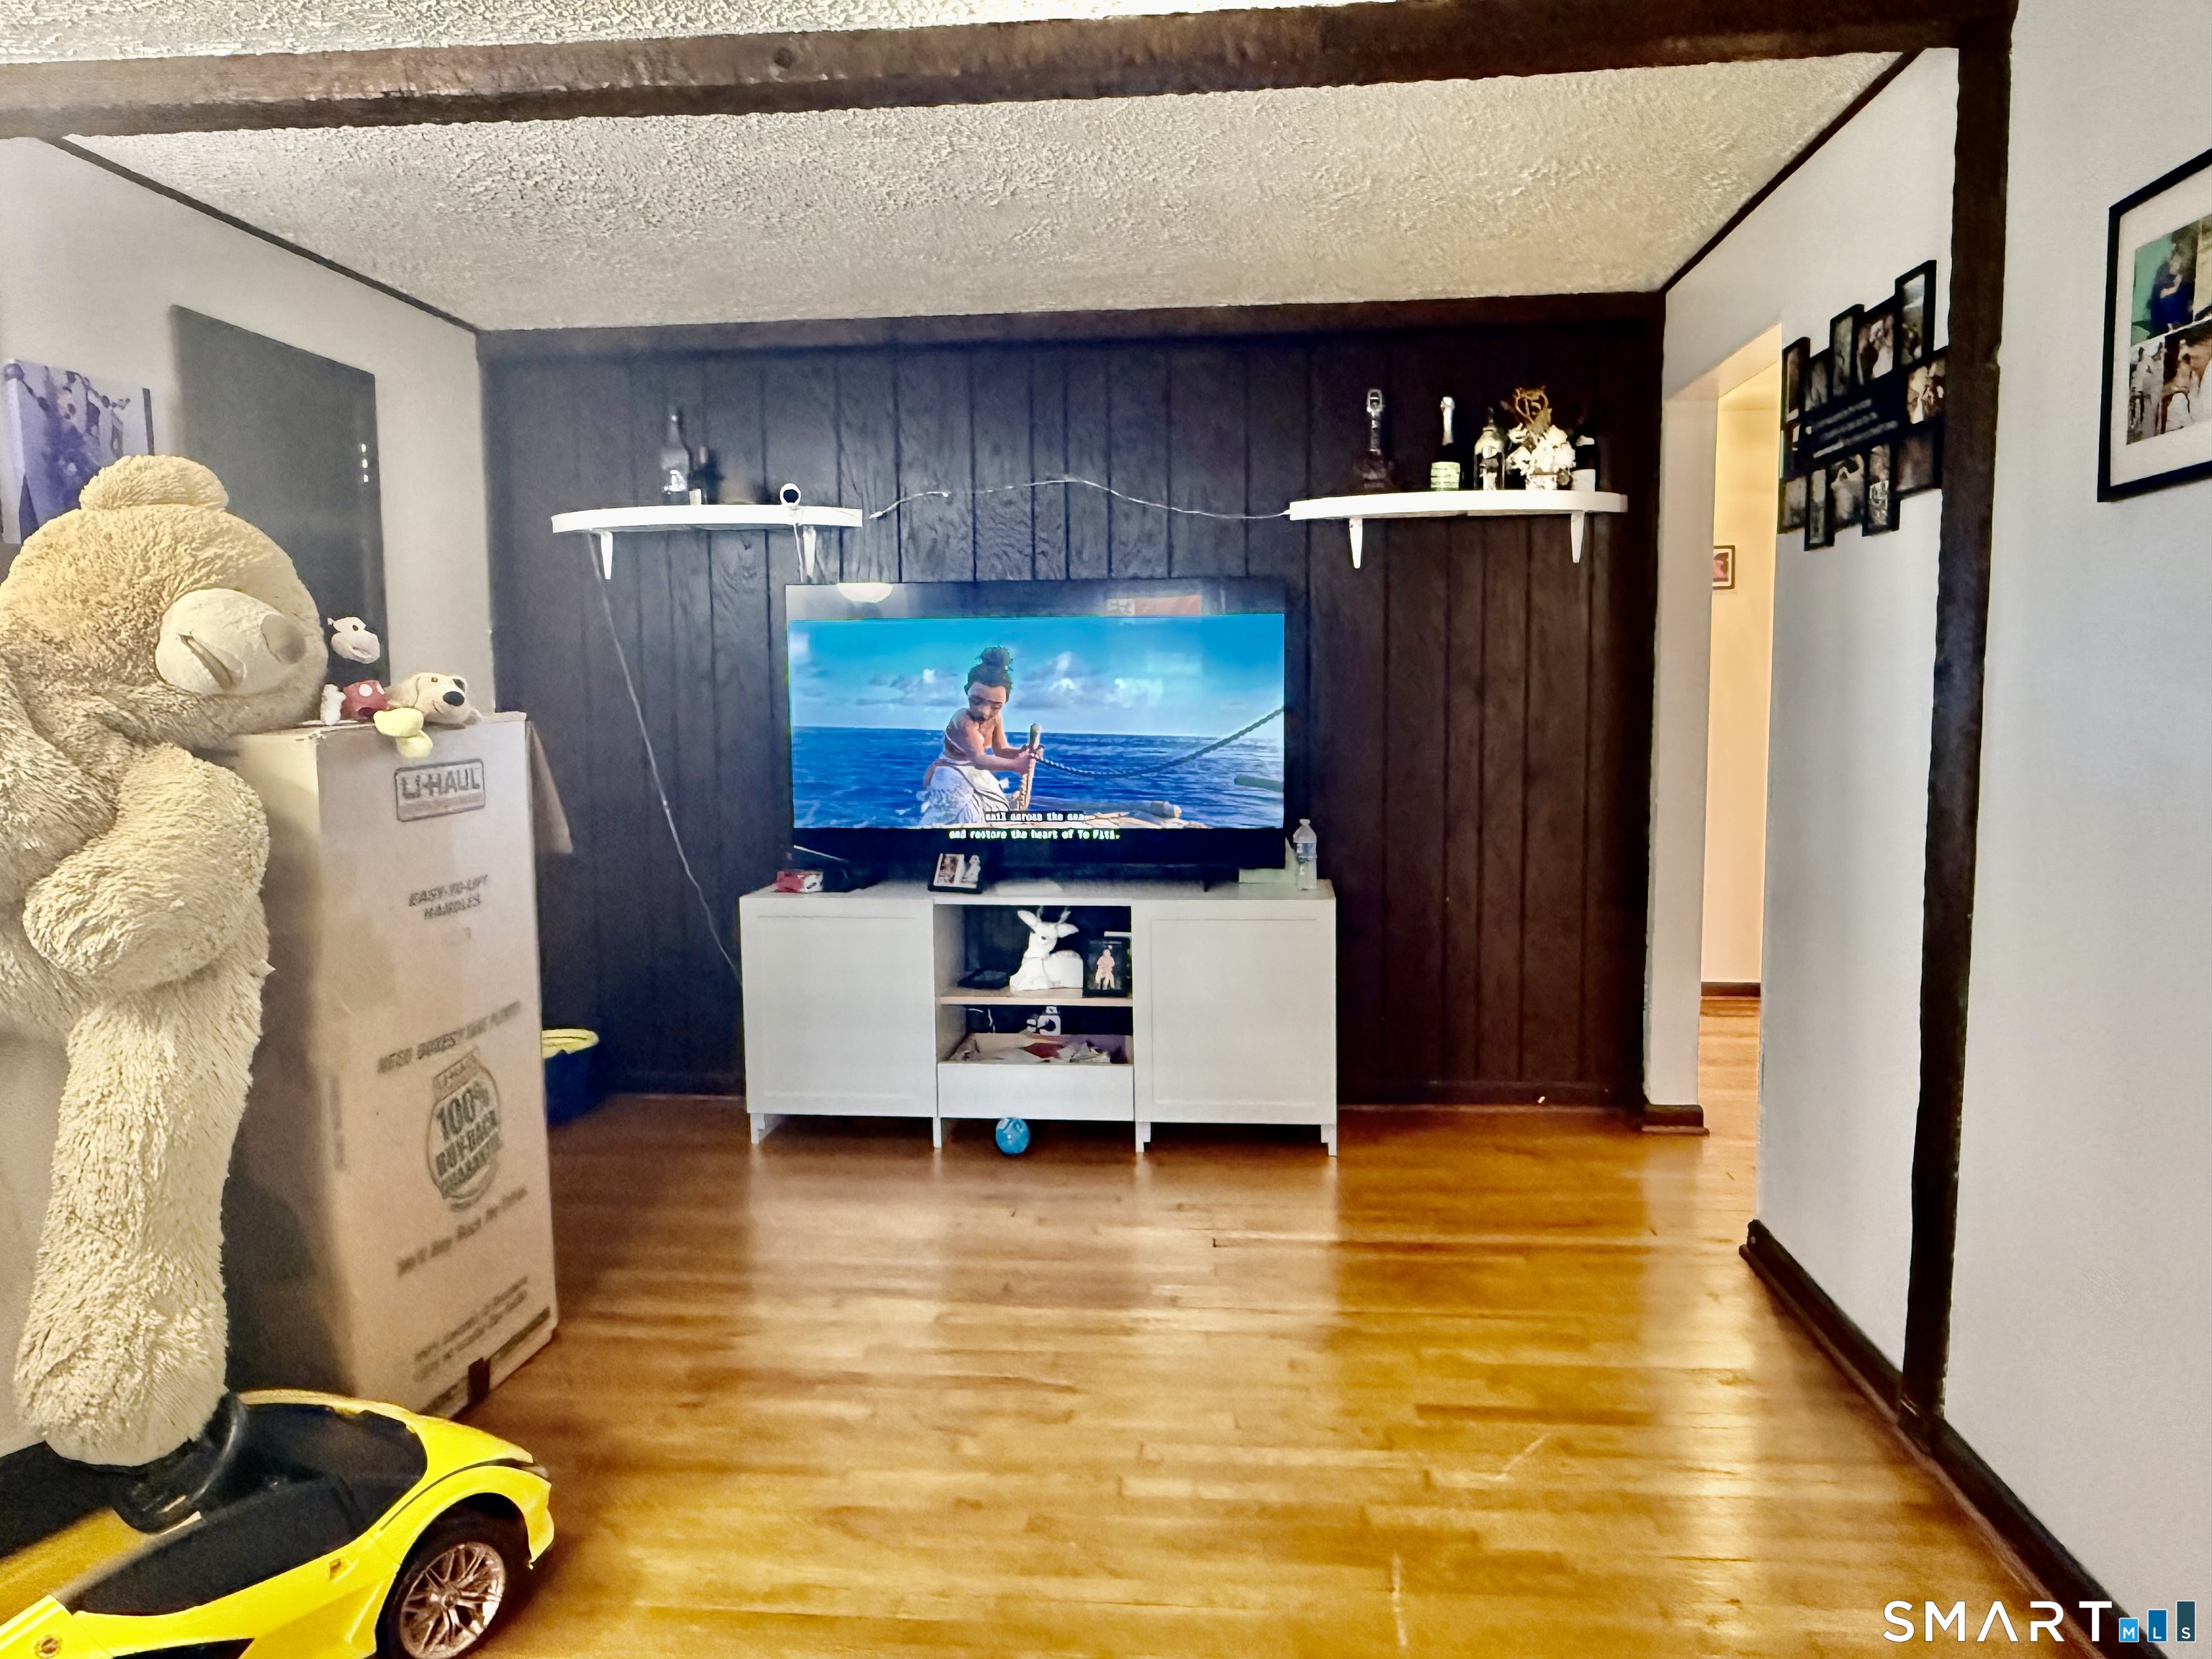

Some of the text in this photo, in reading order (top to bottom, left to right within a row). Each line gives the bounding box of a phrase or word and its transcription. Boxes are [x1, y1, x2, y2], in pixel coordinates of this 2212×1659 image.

[402, 768, 481, 799] U-HAUL
[1010, 813, 1043, 822] across
[1047, 812, 1064, 822] the
[948, 830, 966, 840] and
[970, 830, 1007, 840] restore
[1010, 830, 1028, 840] the
[1031, 830, 1058, 840] heart
[1061, 829, 1074, 840] of
